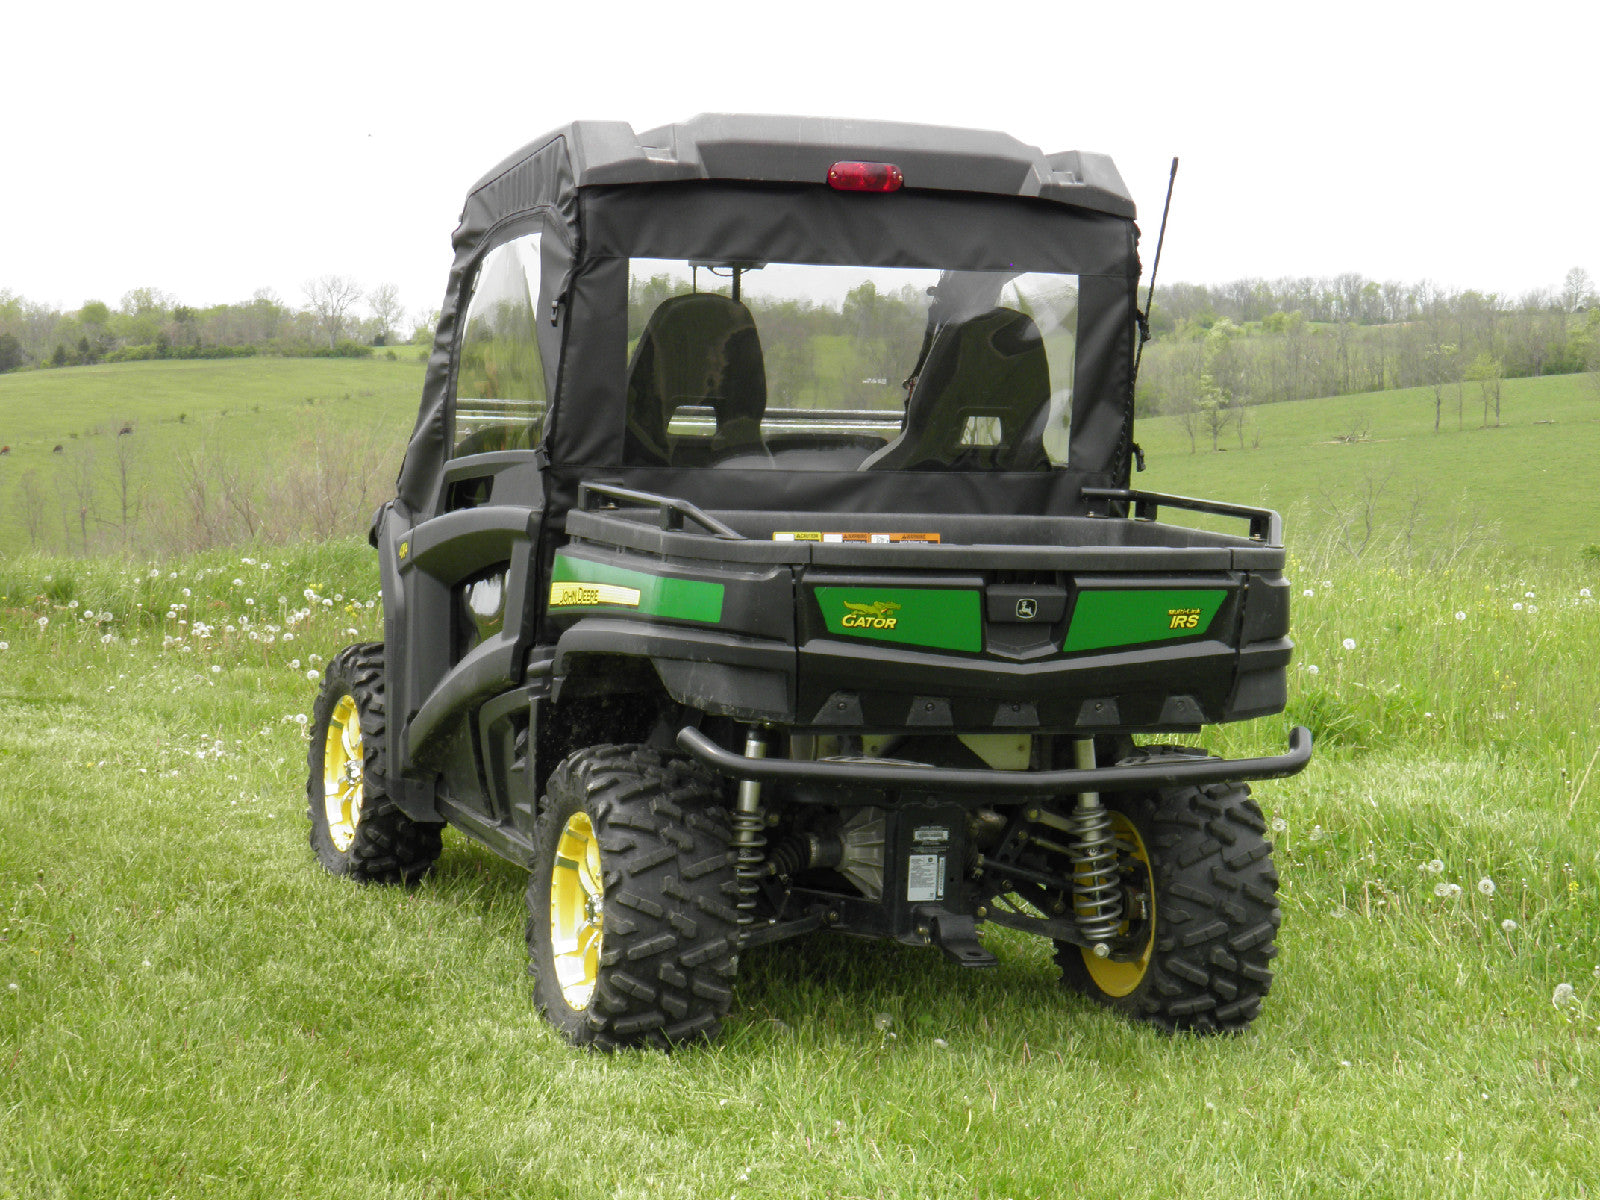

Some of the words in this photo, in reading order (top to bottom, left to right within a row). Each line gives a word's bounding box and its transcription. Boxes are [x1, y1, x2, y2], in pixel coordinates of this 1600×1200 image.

[577, 587, 600, 602] DEERE
[842, 614, 897, 629] GATOR
[1169, 614, 1200, 629] IRS
